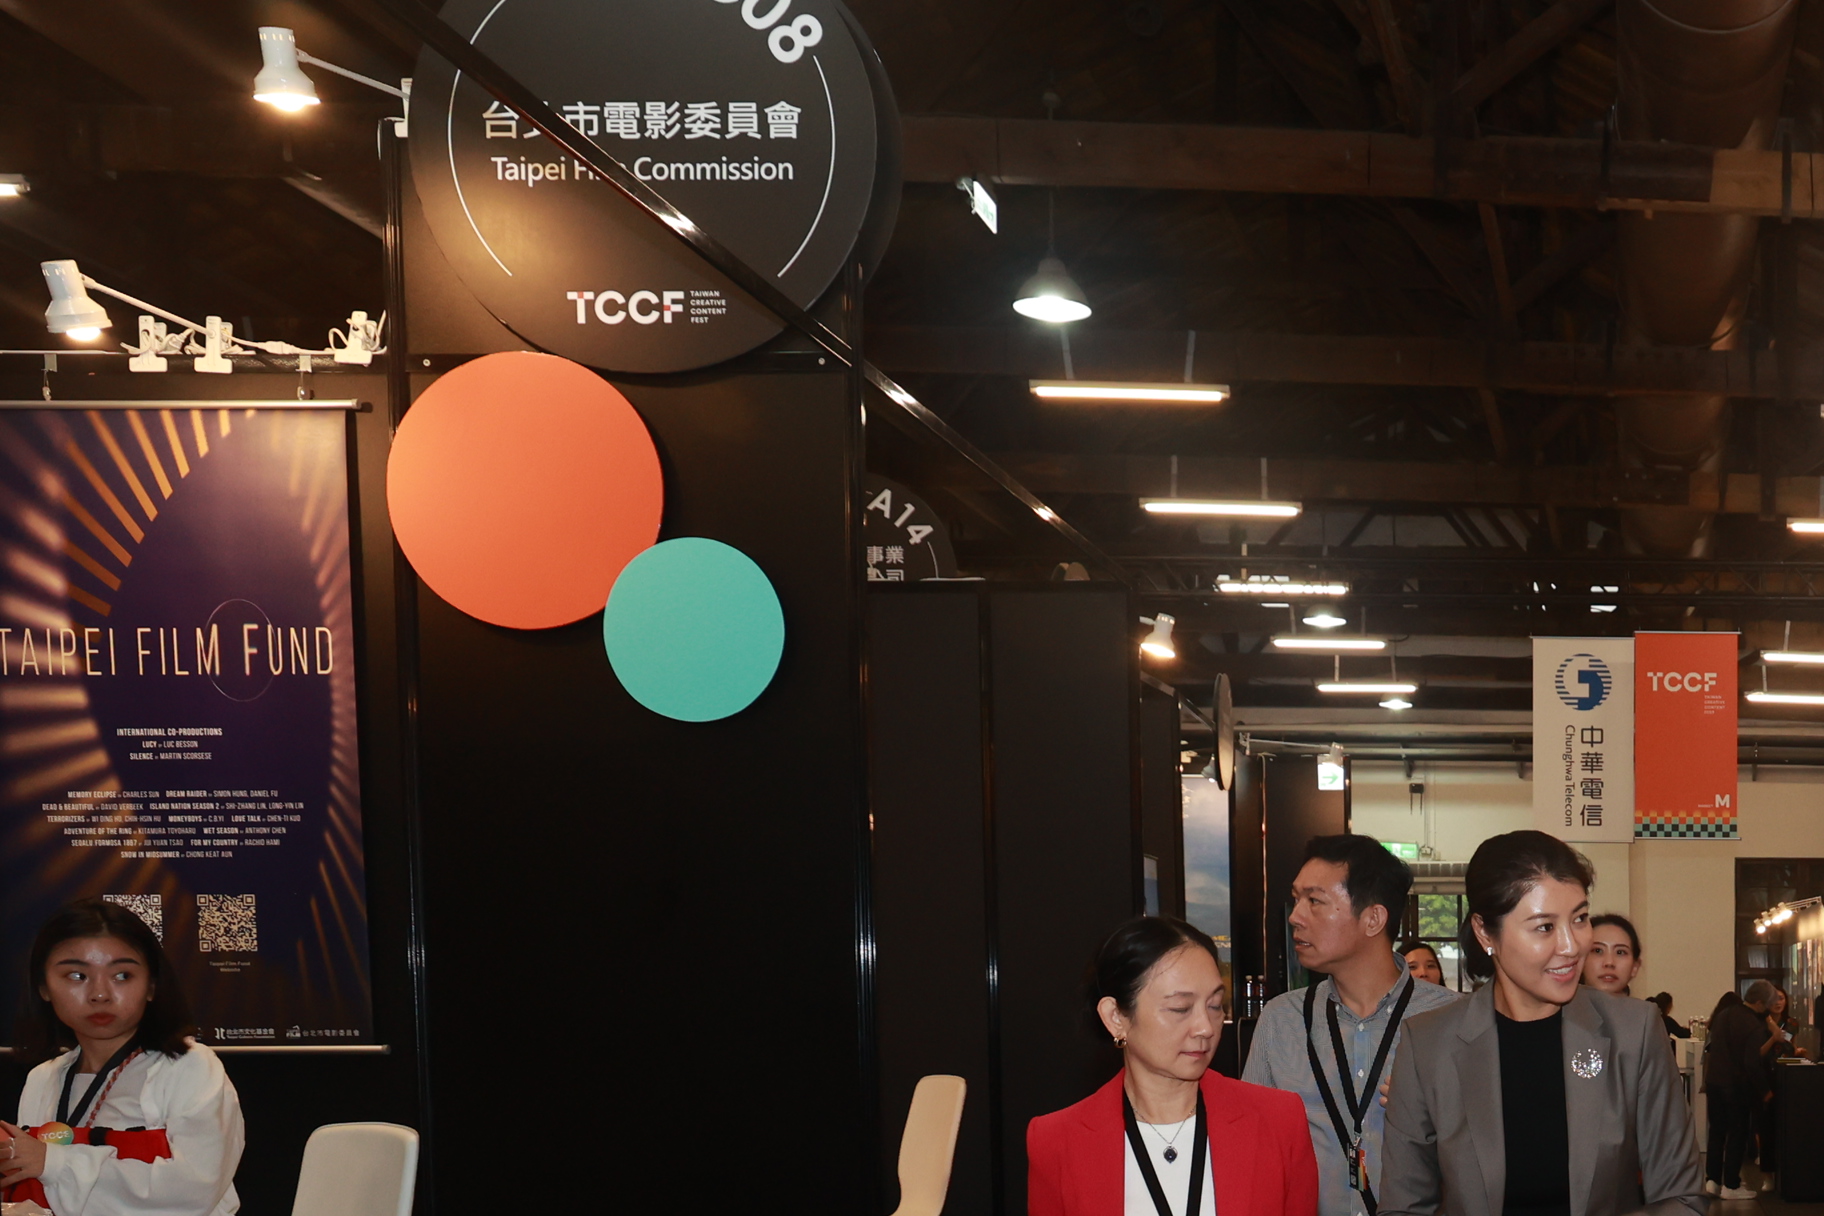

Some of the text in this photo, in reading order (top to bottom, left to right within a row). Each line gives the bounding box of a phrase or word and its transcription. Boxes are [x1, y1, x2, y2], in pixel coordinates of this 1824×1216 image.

[713, 0, 823, 63] 08
[482, 101, 802, 140] 台市電影委員會
[491, 157, 566, 187] Taipei
[634, 157, 794, 181] Commission
[566, 290, 684, 324] TCCF
[866, 488, 934, 545] A14
[0, 623, 334, 676] TAIPEI FILM FUND
[1647, 672, 1718, 692] TCCF
[116, 727, 223, 736] INTERNATIONAL CO-PRODUCTIONS
[142, 740, 157, 748] LUCY
[129, 752, 154, 760] SILENCE
[159, 752, 182, 760] MARTIN
[1562, 724, 1576, 827] Chunghwa Telecom
[1580, 725, 1604, 827] 中華電信
[1715, 794, 1730, 808] M
